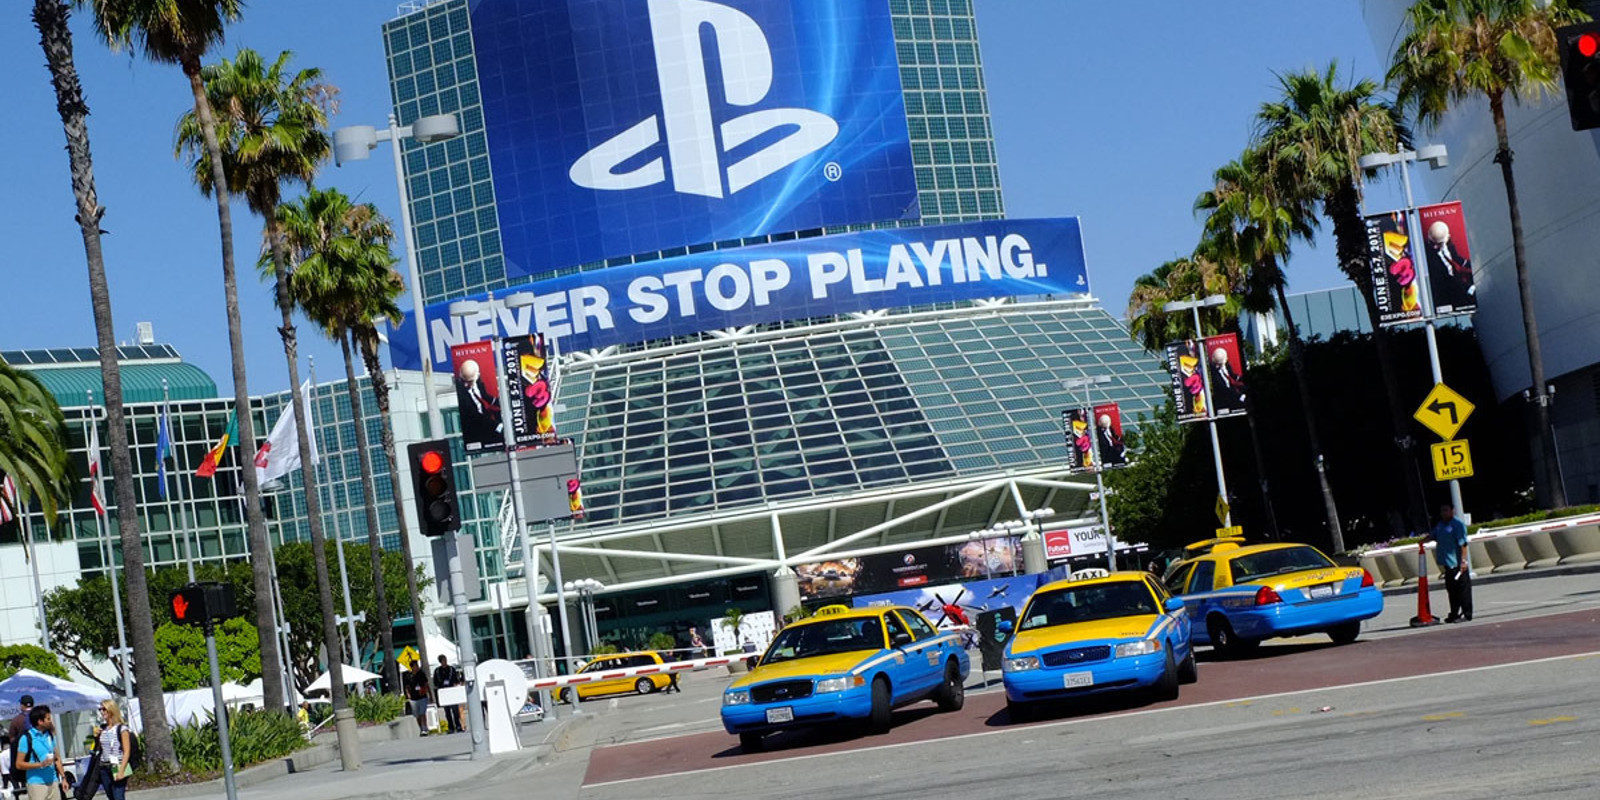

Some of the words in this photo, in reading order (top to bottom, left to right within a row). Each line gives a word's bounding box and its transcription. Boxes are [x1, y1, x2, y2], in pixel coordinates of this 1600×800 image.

[1424, 208, 1457, 218] HITMAN
[1368, 227, 1379, 252] 2012
[431, 285, 614, 364] NEVER
[628, 259, 791, 324] STOP
[807, 233, 1048, 300] PLAYING.
[1376, 277, 1388, 312] JUNE
[456, 347, 487, 357] HITMAN
[505, 350, 517, 376] 2012
[1173, 388, 1184, 413] JUNE
[512, 399, 524, 433] JUNE
[1440, 445, 1464, 466] 15
[1442, 466, 1466, 476] MPH
[1074, 570, 1103, 580] TAXI
[820, 607, 840, 616] TAXI
